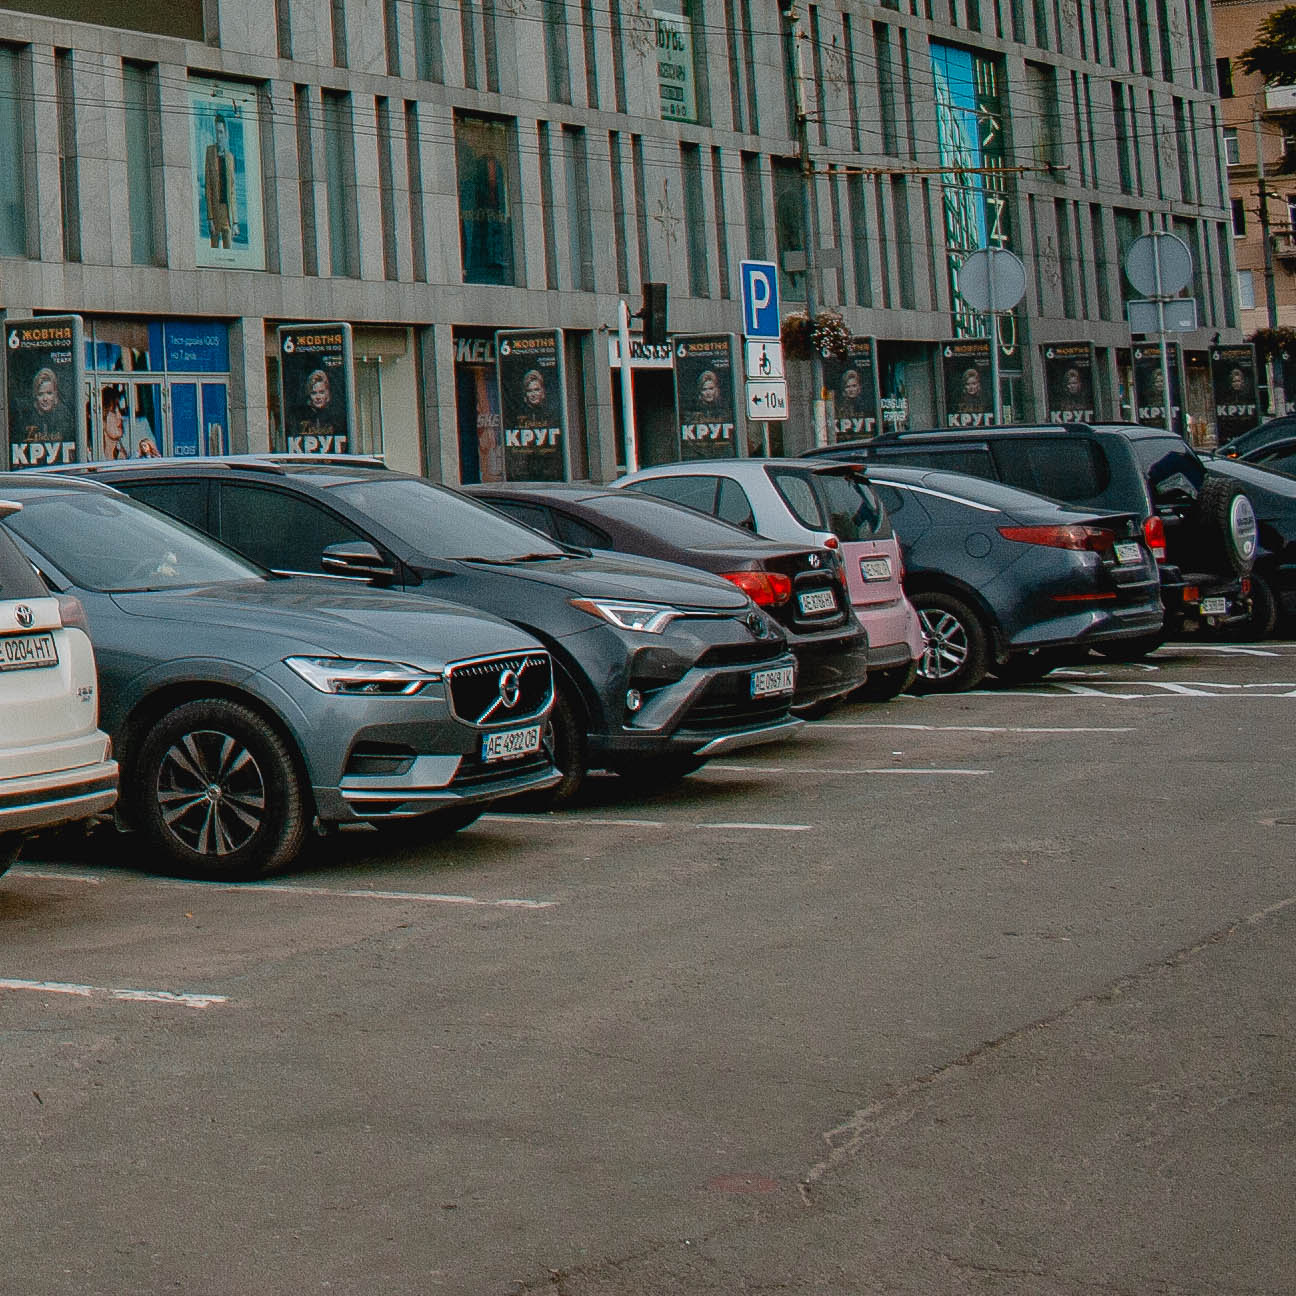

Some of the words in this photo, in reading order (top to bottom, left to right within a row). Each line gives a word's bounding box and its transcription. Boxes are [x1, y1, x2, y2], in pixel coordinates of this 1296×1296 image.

[749, 270, 770, 329] P
[8, 329, 20, 349] 6
[22, 327, 72, 340] ЖОВТНЯ
[204, 335, 219, 346] IQOS
[284, 335, 294, 353] 6
[296, 334, 342, 345] ЖОВТНЯ
[501, 339, 511, 356] 6
[512, 338, 555, 349] ЖОВТНЯ
[677, 343, 687, 358] 6
[944, 346, 952, 357] 6
[764, 392, 777, 409] 10
[1051, 410, 1093, 423] КРУГ
[1217, 405, 1255, 417] КРУГ
[948, 413, 994, 427] КРУГ
[505, 428, 560, 447] КРУГ
[681, 424, 734, 440] КРУГ
[175, 445, 195, 455] IQOS
[288, 435, 347, 454] КРУГ
[12, 442, 75, 465] КРУГ
[5, 639, 35, 662] 0204
[36, 637, 50, 658] HT
[488, 735, 501, 756] AE
